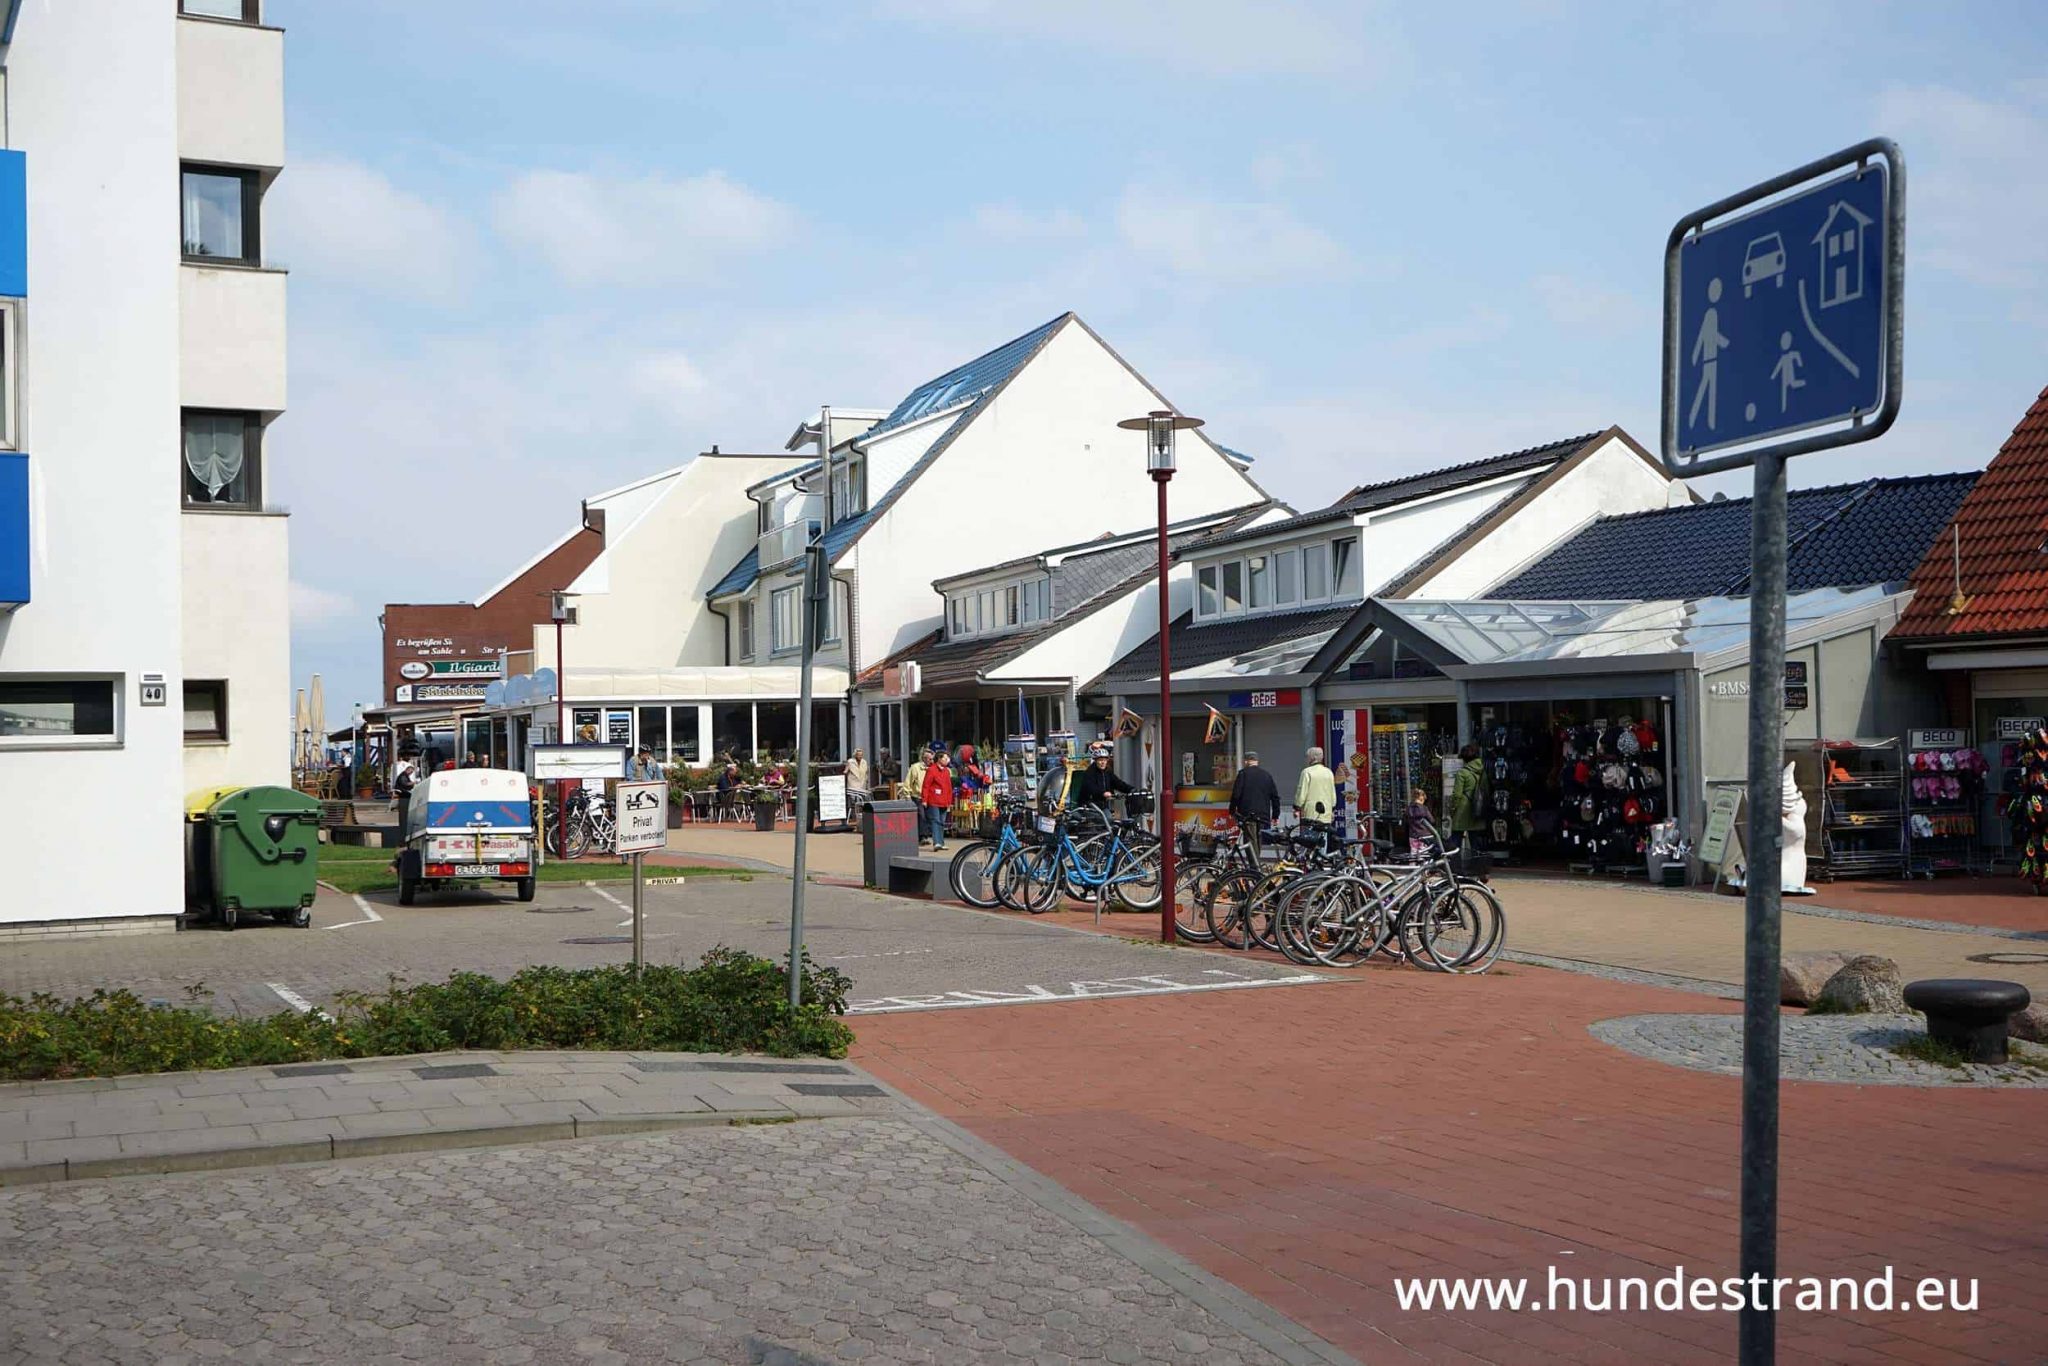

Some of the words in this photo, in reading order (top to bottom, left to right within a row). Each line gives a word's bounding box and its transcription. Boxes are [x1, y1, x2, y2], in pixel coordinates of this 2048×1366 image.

[145, 687, 161, 700] 40
[1719, 681, 1747, 695] BMS
[2003, 720, 2041, 732] BECO
[1923, 731, 1955, 742] BECO
[633, 816, 653, 828] Privat
[620, 834, 639, 843] Parken
[640, 829, 665, 840] verboten!
[466, 839, 519, 850] Kwasaki
